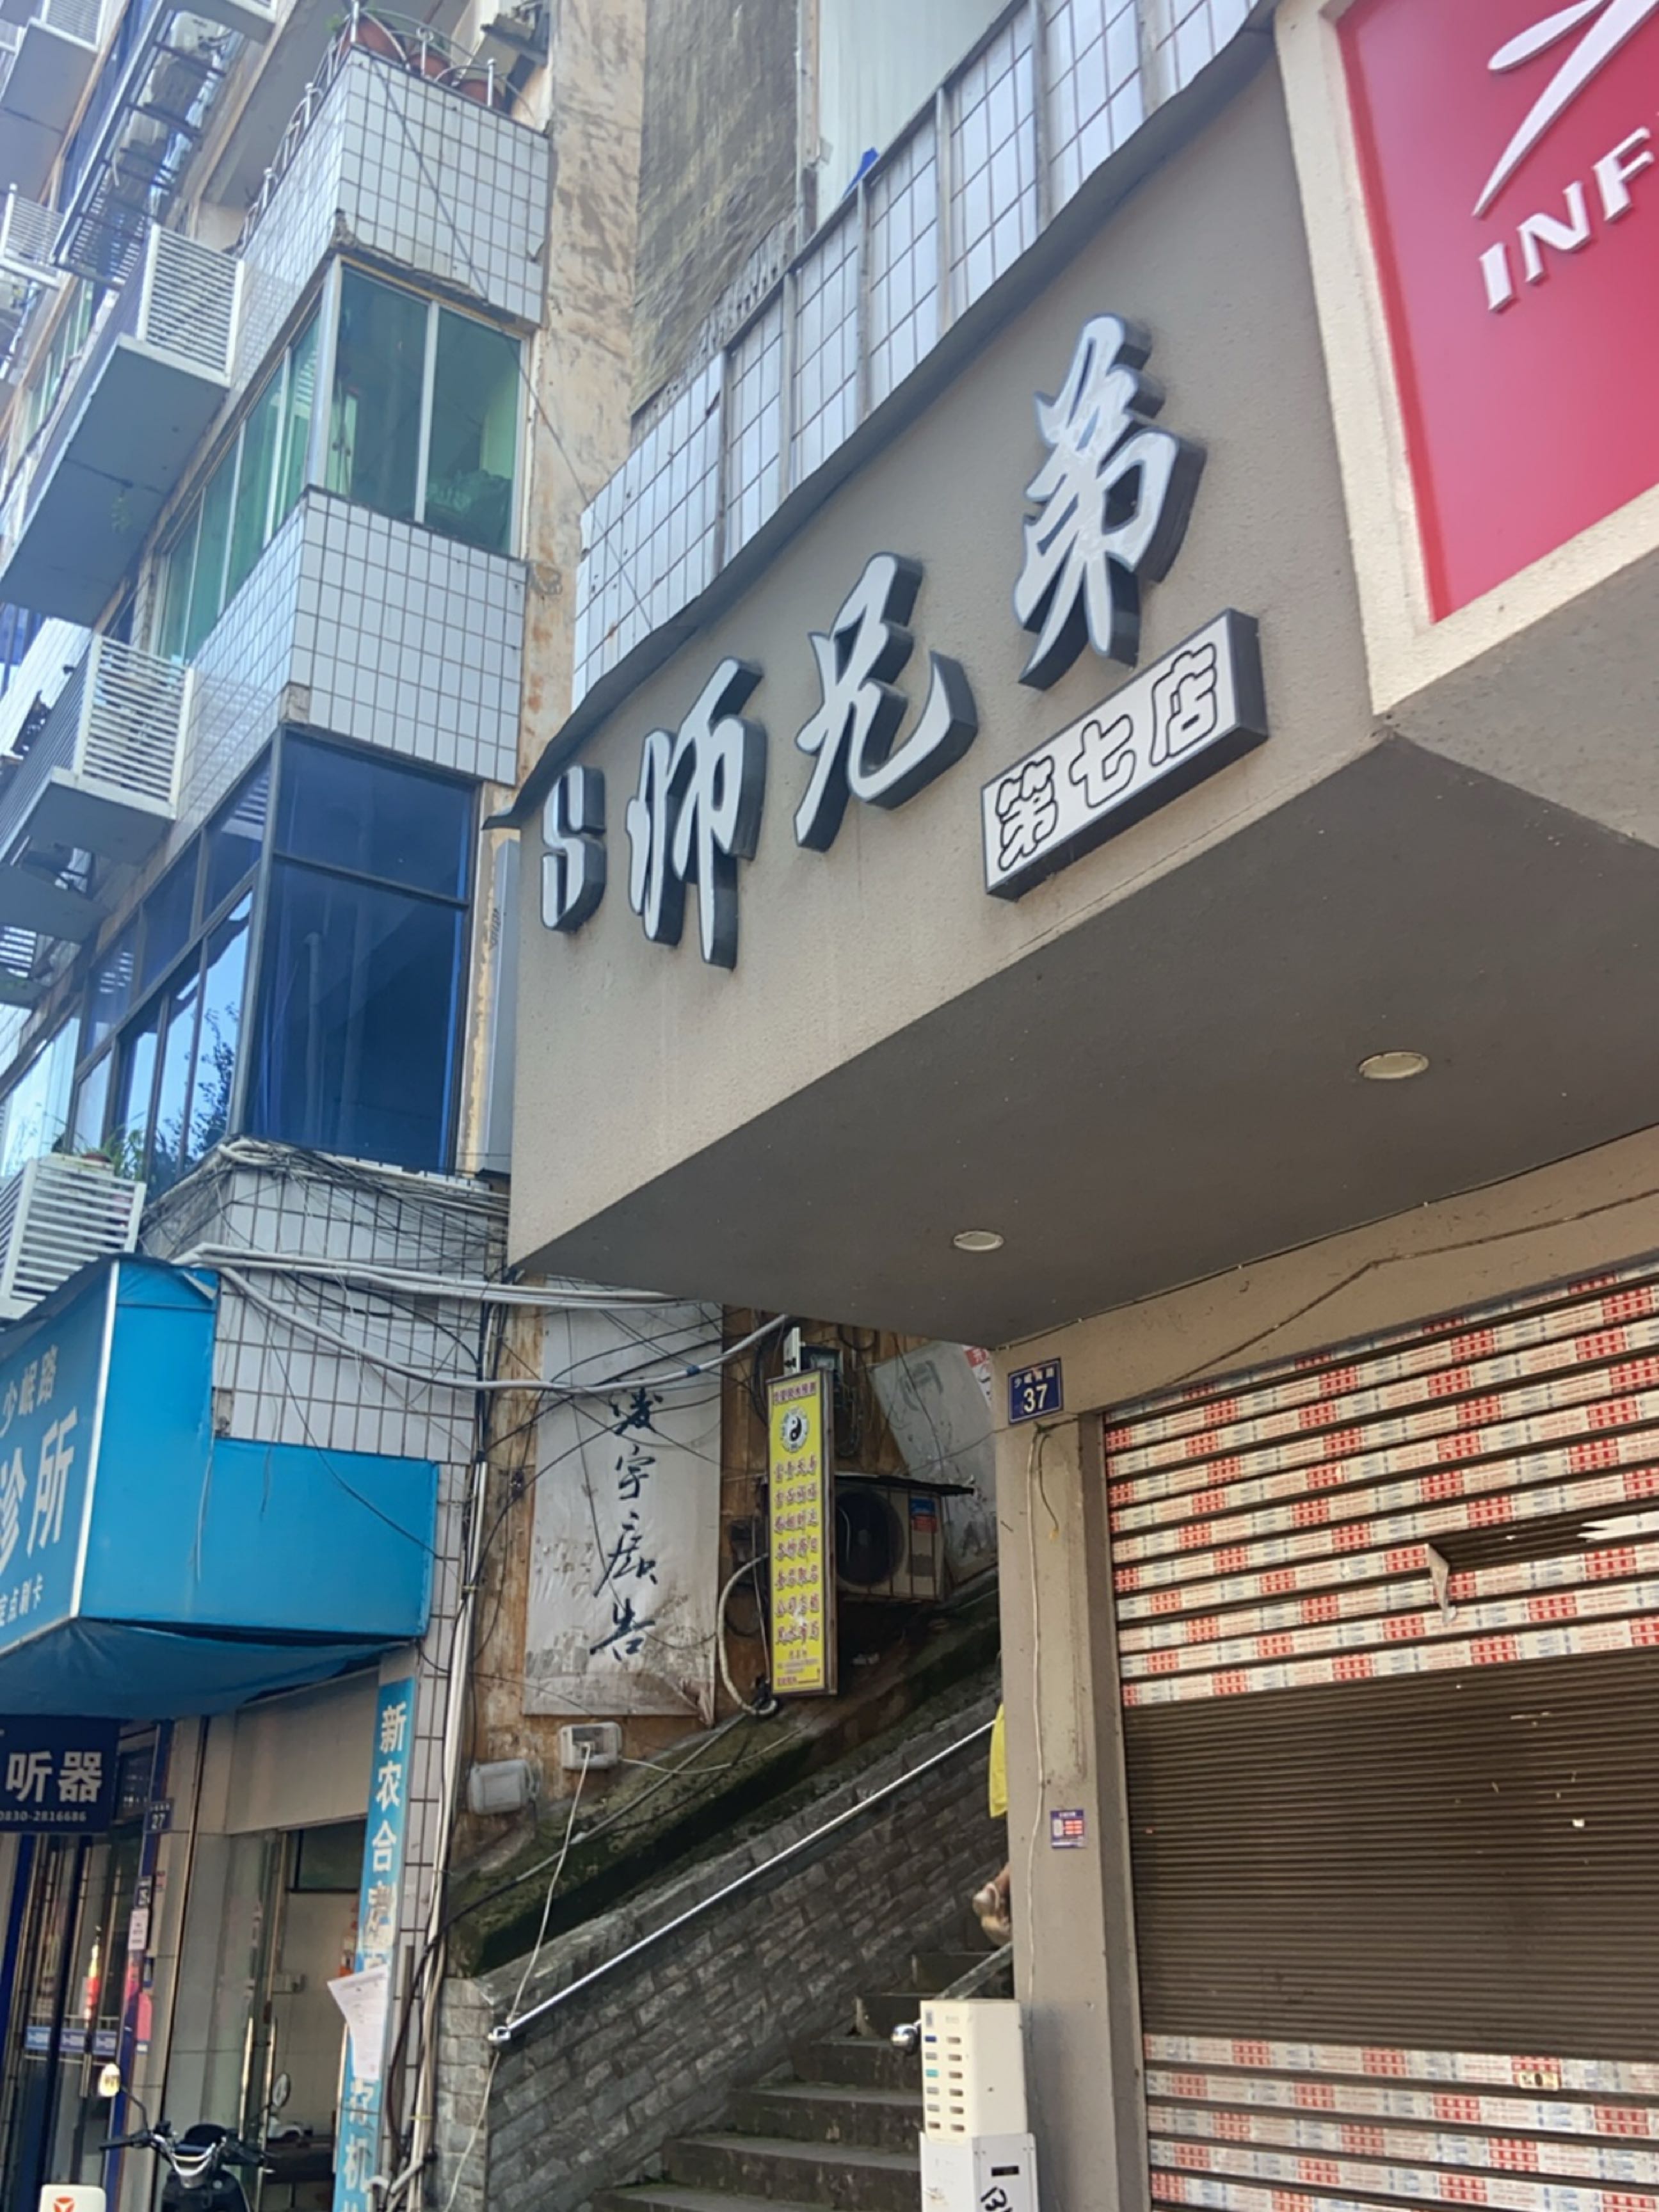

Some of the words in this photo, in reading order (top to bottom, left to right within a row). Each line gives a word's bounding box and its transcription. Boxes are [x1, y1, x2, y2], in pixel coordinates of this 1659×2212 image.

[995, 642, 1218, 872] 第七店
[1024, 1383, 1048, 1413] 37
[5, 1751, 102, 1802] 听器
